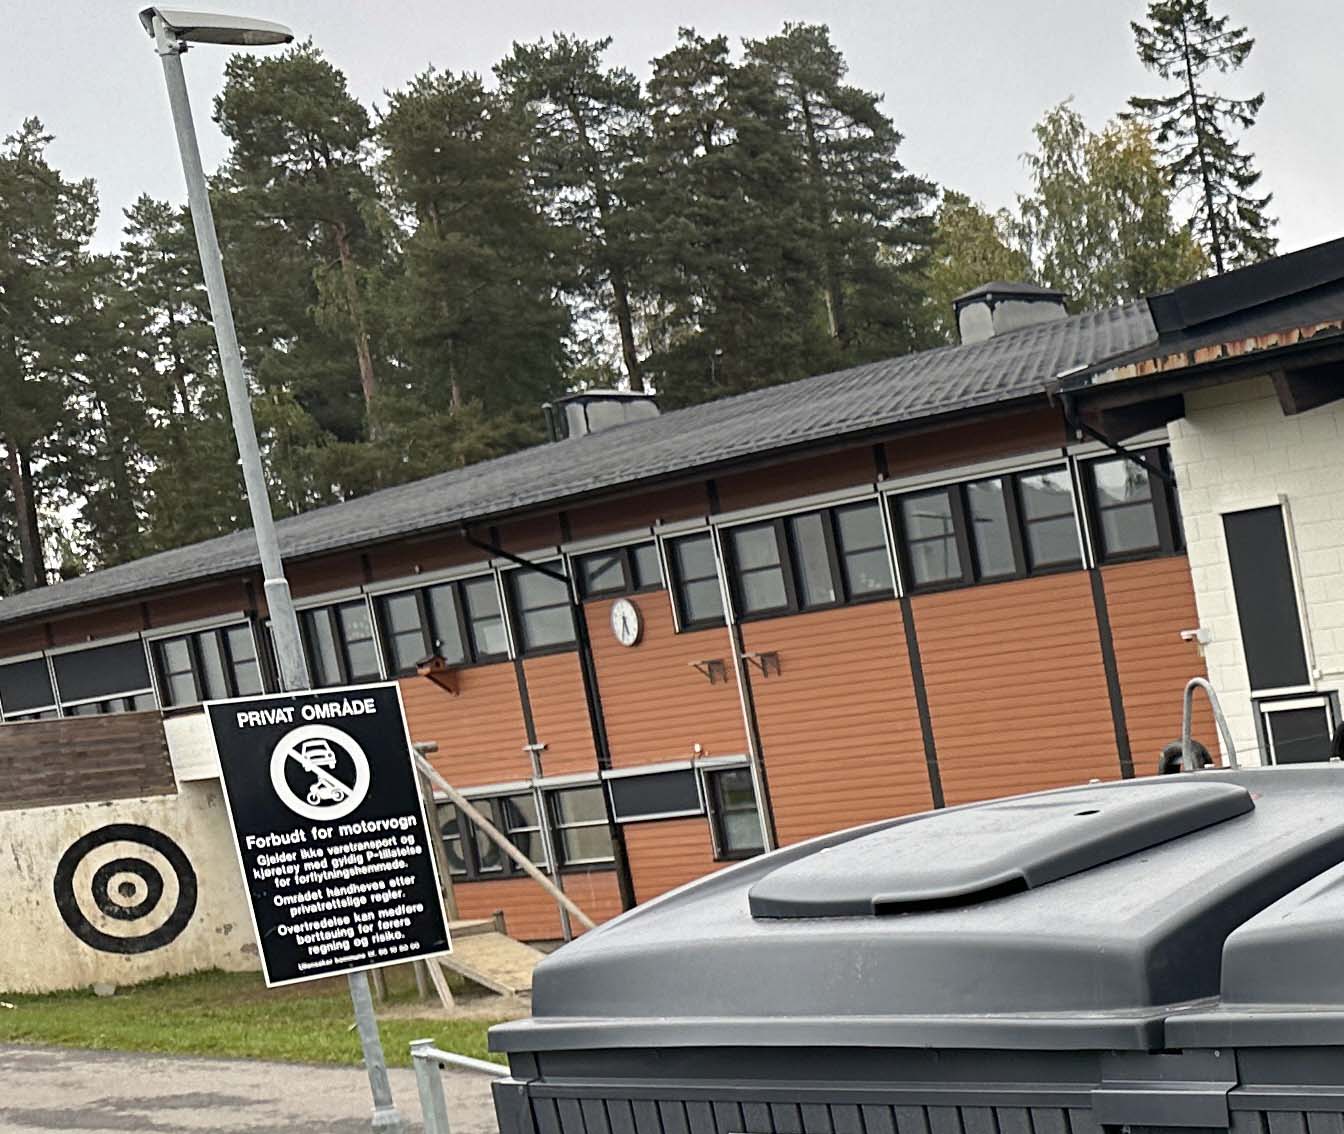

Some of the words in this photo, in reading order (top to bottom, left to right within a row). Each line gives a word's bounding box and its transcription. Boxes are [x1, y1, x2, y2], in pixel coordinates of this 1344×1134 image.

[236, 706, 295, 728] PRIVAT
[301, 697, 376, 720] OMRÅDE
[245, 829, 307, 850] Forbudt
[311, 826, 333, 841] for
[338, 815, 417, 837] motorvogn
[253, 863, 300, 881] kjøretøy
[304, 858, 328, 872] med
[331, 853, 364, 869] gyldig
[367, 845, 422, 861] P-tillatelse
[256, 852, 297, 867] Gjelder
[300, 847, 324, 860] ikke
[327, 836, 397, 856] varetransport
[400, 834, 415, 846] og
[274, 877, 291, 888] for
[295, 859, 409, 885] forflytningshemmede.
[273, 889, 323, 906] Området
[326, 879, 386, 898] håndheves
[389, 875, 416, 887] etter
[290, 895, 367, 918] privatrettslige
[370, 888, 406, 904] regler.
[277, 915, 350, 936] Overtredelse
[353, 910, 376, 923] kan
[378, 903, 424, 918] medføre
[296, 926, 354, 945] borttauing
[357, 923, 373, 934] for
[378, 917, 411, 931] førers
[308, 939, 350, 956] regning
[353, 936, 369, 948] og
[372, 930, 405, 944] risiko.
